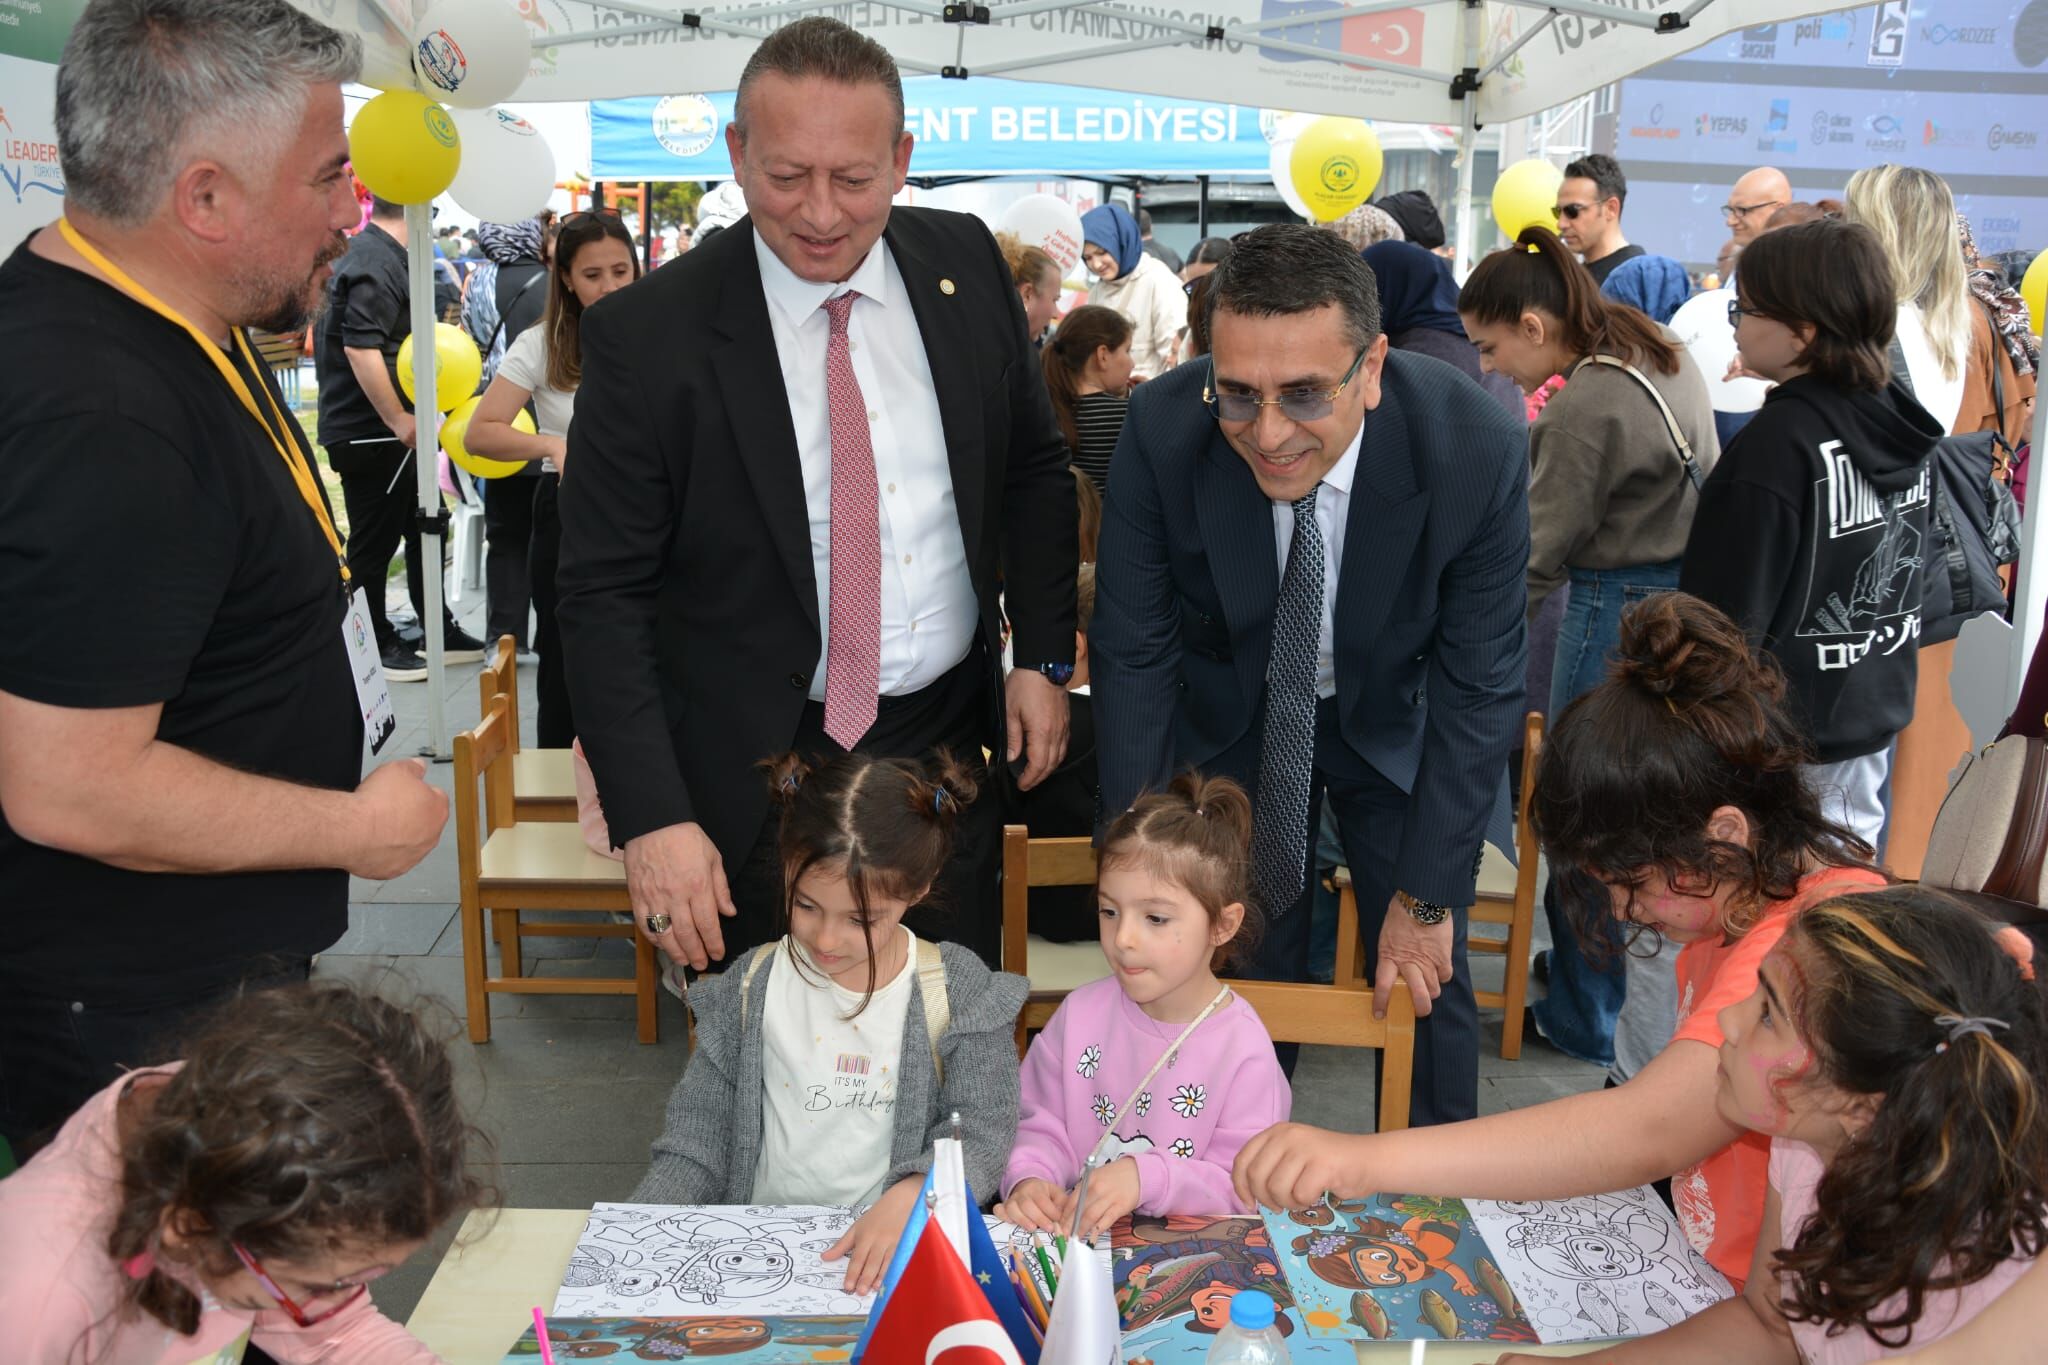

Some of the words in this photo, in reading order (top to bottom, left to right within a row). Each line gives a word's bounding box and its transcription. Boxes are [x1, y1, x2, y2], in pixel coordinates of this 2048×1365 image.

[991, 100, 1237, 142] BELEDİYESİ
[6, 139, 58, 163] LEADER
[834, 1076, 850, 1087] IT'S
[853, 1078, 868, 1089] MY
[804, 1084, 896, 1114] Birthday
